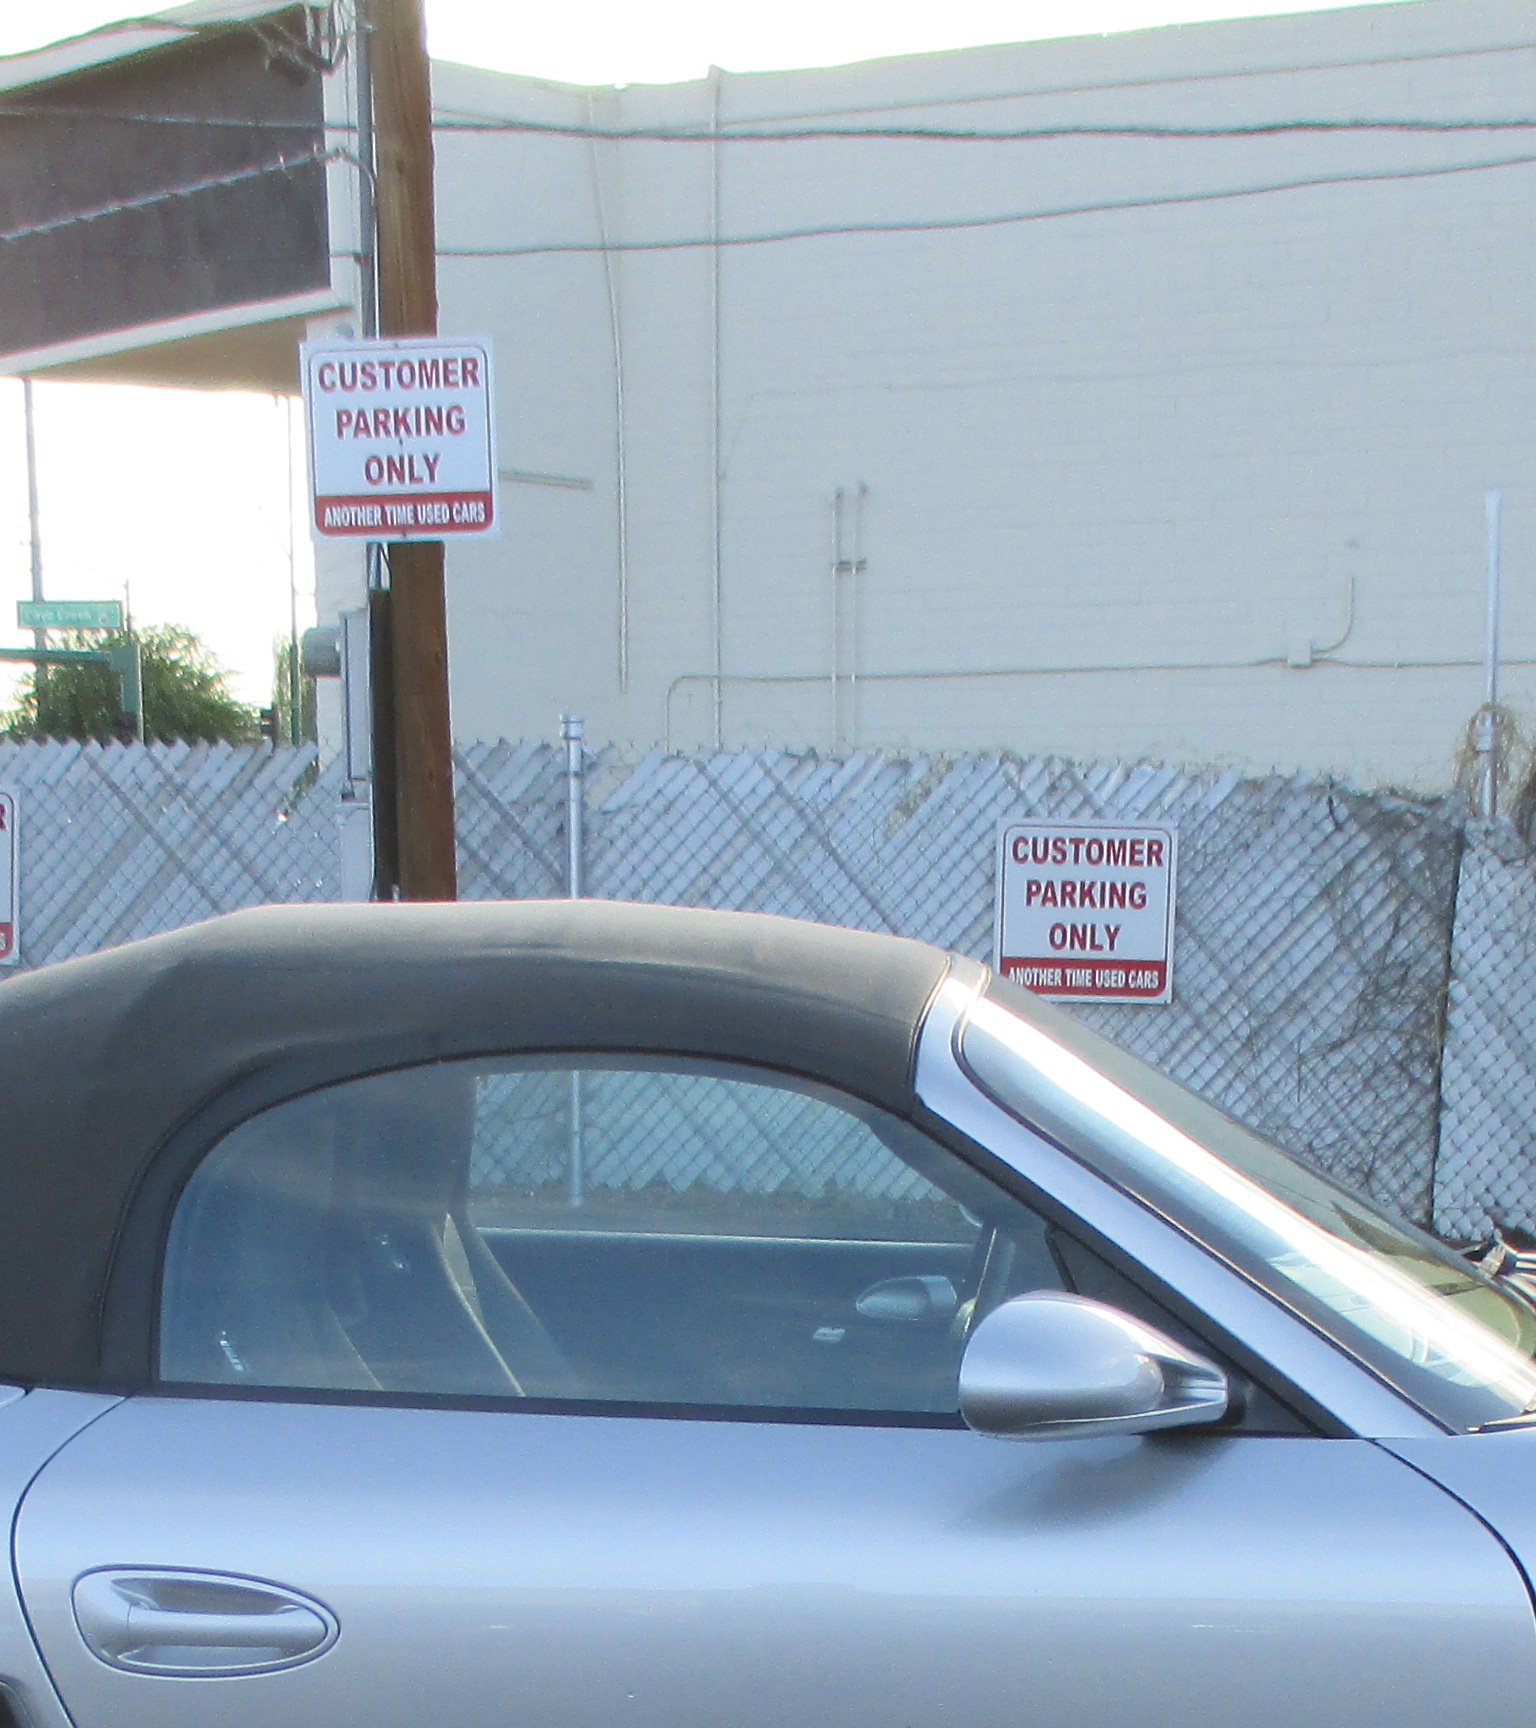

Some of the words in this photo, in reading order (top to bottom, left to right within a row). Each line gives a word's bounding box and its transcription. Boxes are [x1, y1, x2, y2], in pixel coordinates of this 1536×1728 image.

[318, 357, 480, 393] CUSTOMER
[335, 405, 465, 440] PARKING
[364, 453, 441, 485] ONLY
[324, 505, 382, 527] ANOTHER
[384, 503, 414, 526] TIME
[417, 502, 450, 525] USED
[452, 500, 485, 523] CARS
[1012, 836, 1163, 867] CUSTOMER
[1025, 879, 1147, 910] PARKING
[1048, 923, 1121, 951] ONLY
[1008, 966, 1062, 987] ANOTHER
[1065, 968, 1092, 987] TIME
[1095, 969, 1125, 988] USED
[1128, 969, 1159, 989] CARS
